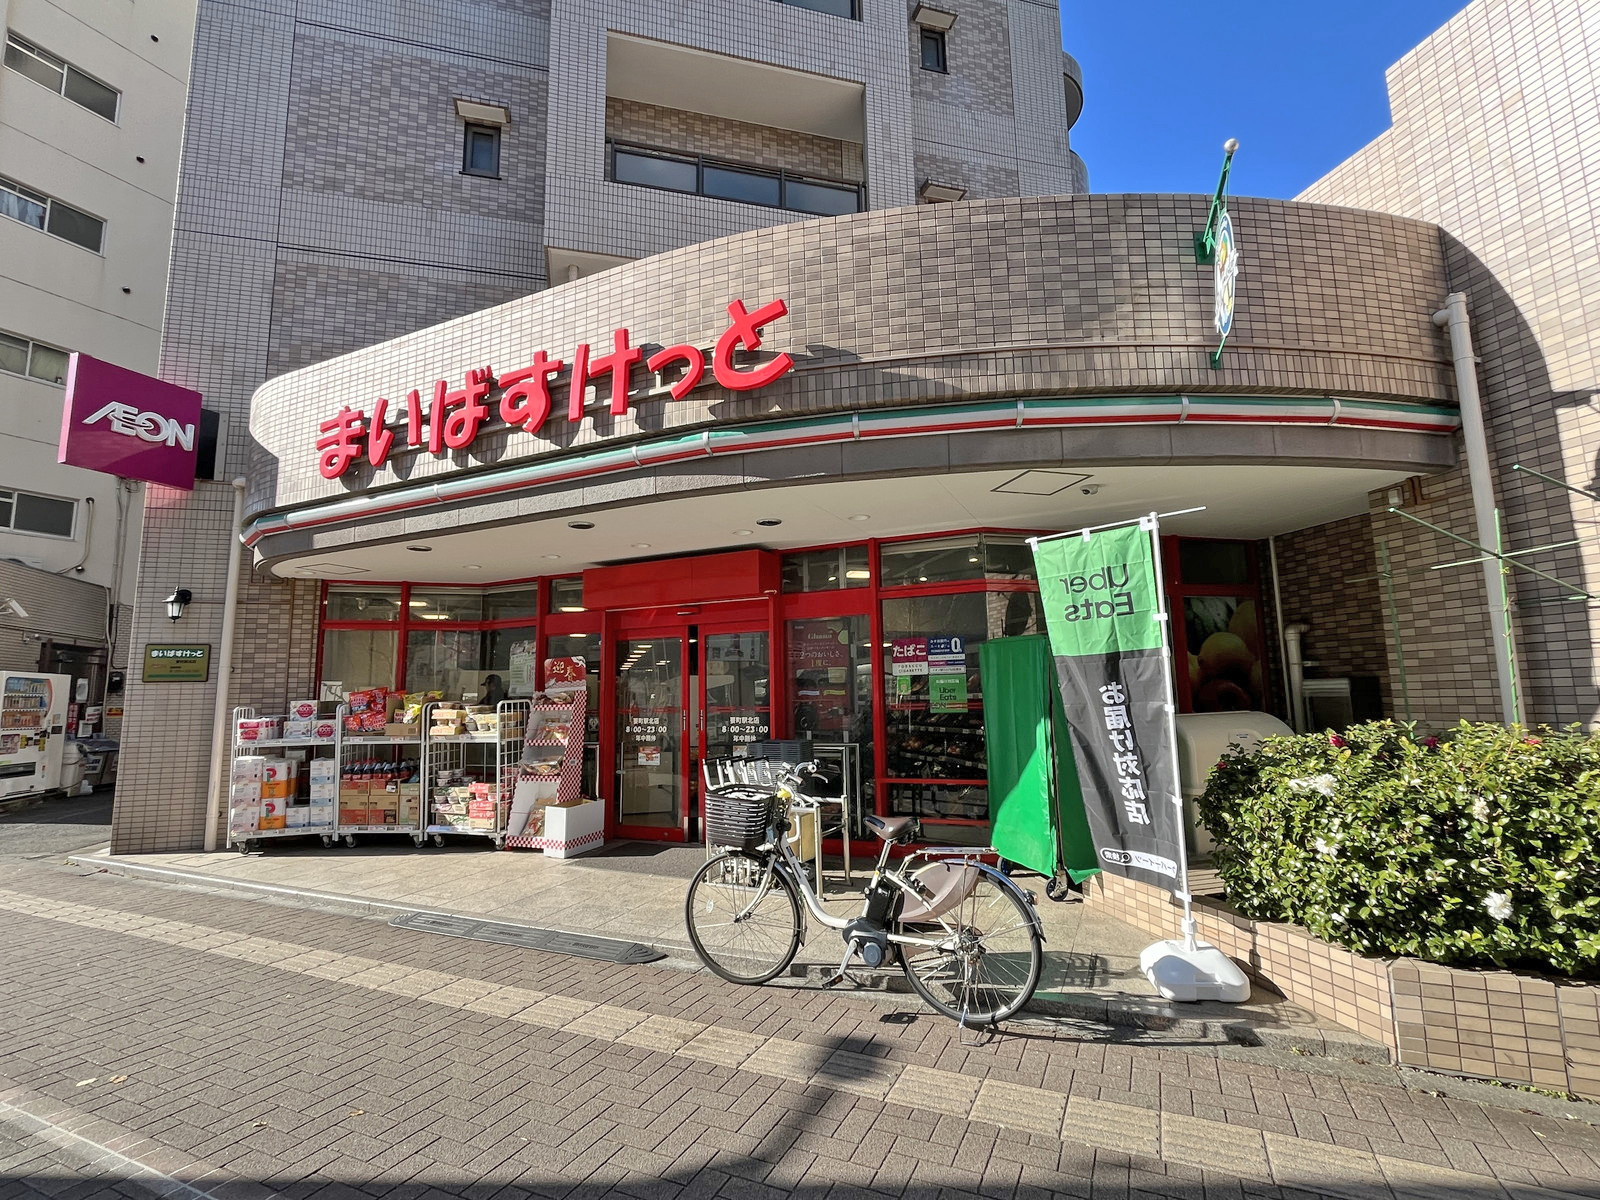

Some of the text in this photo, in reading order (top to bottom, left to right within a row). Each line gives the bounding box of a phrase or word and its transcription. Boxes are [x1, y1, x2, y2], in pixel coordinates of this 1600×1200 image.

[316, 298, 795, 480] まいばすけっと
[82, 401, 195, 451] AEON
[893, 644, 927, 657] たばこ
[552, 661, 577, 683] 迎春
[940, 693, 957, 701] Eats
